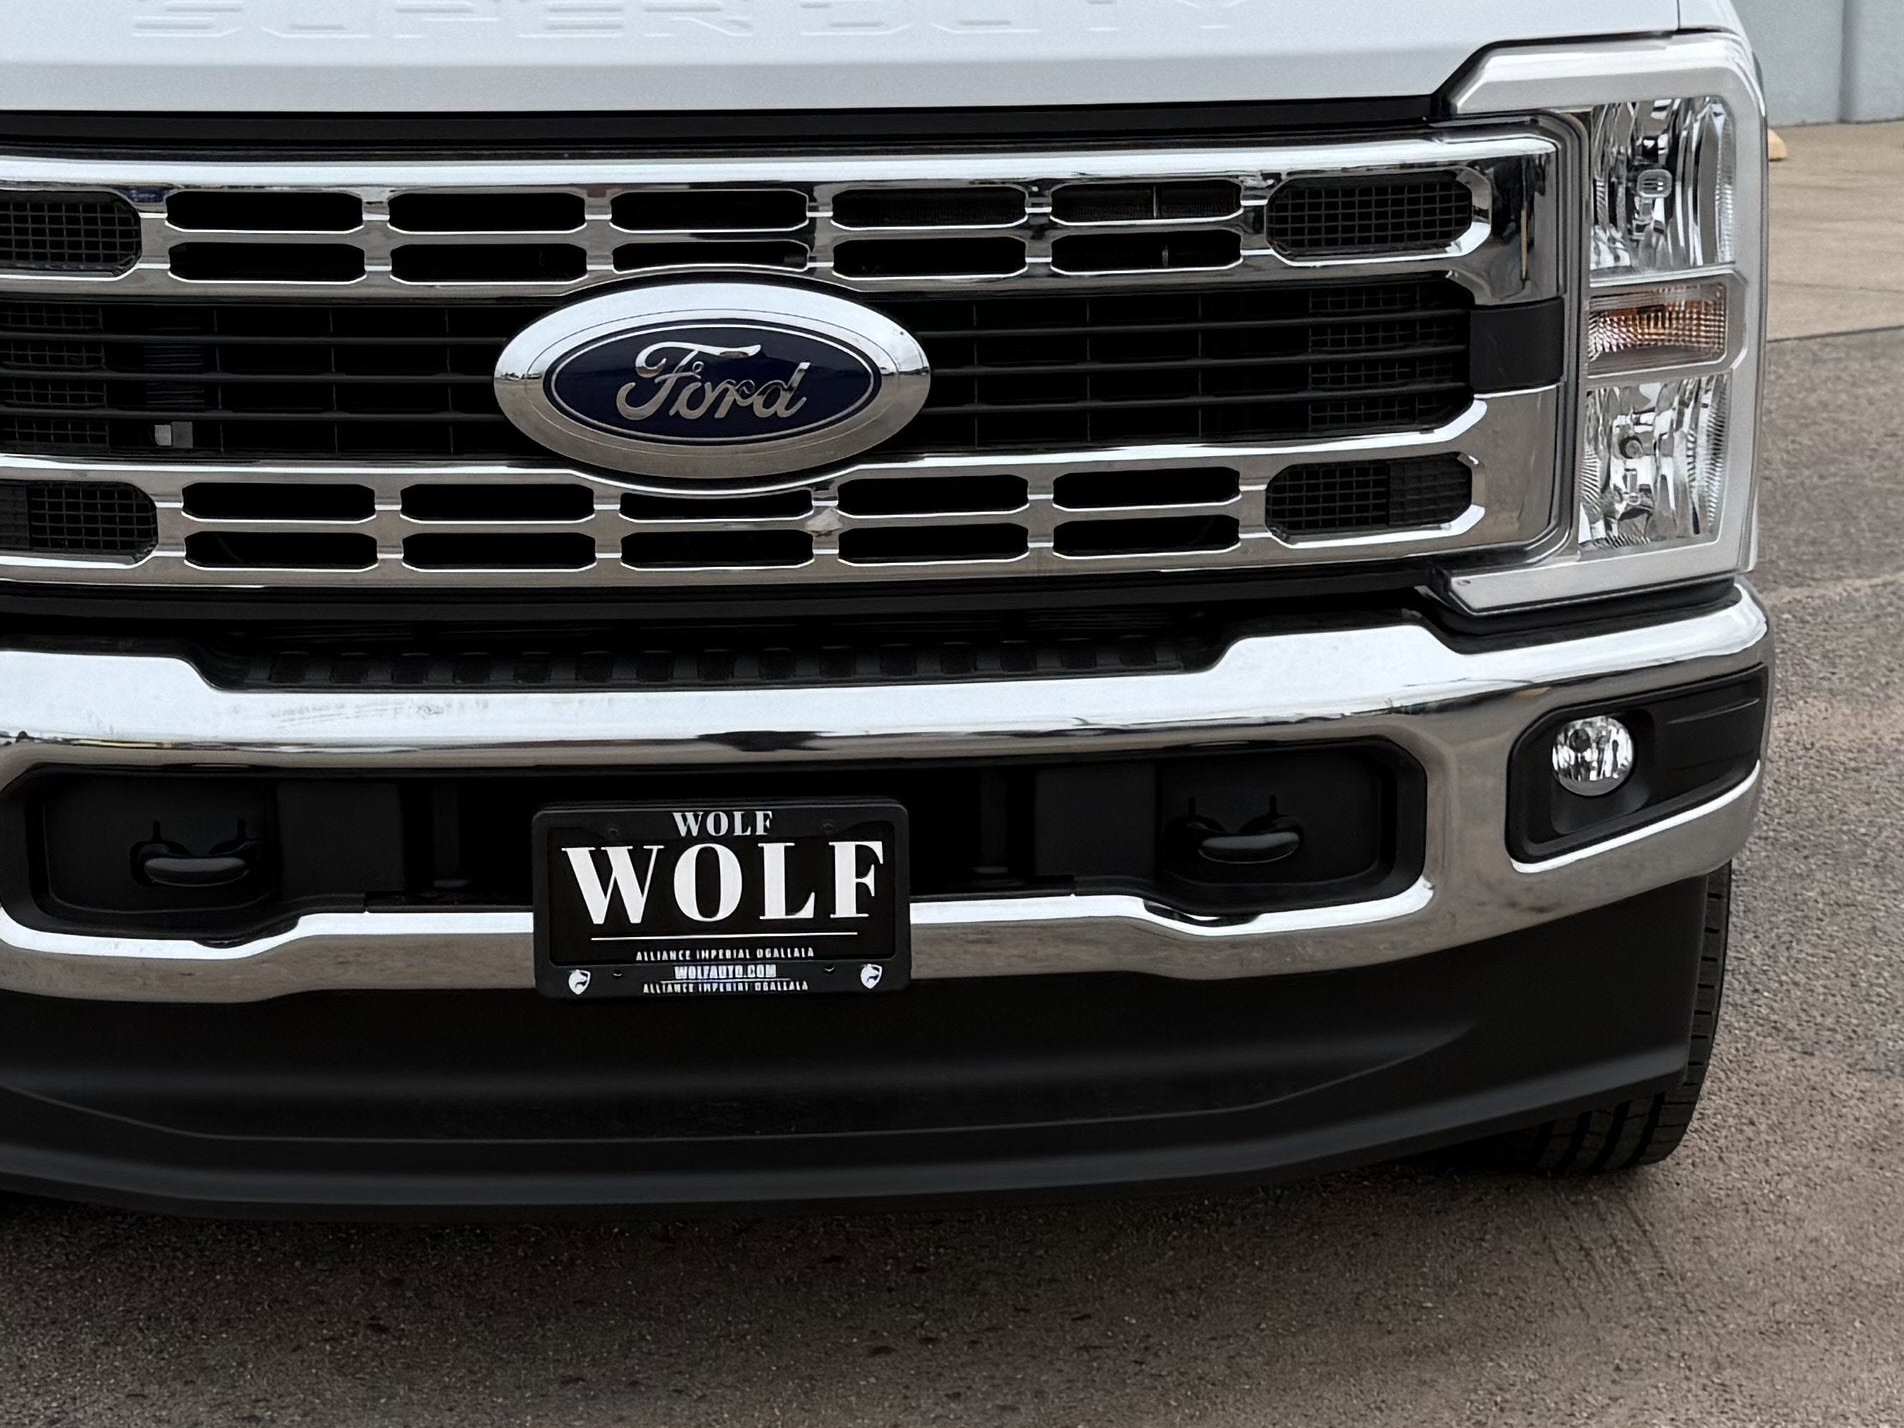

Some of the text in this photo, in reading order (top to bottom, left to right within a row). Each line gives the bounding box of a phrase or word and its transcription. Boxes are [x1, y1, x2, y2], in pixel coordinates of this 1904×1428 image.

[615, 340, 812, 421] Ford
[672, 810, 773, 837] WOLF
[561, 841, 884, 925] WOLF
[635, 949, 691, 961] ALLIANCE
[696, 947, 751, 960] IMPERIAL
